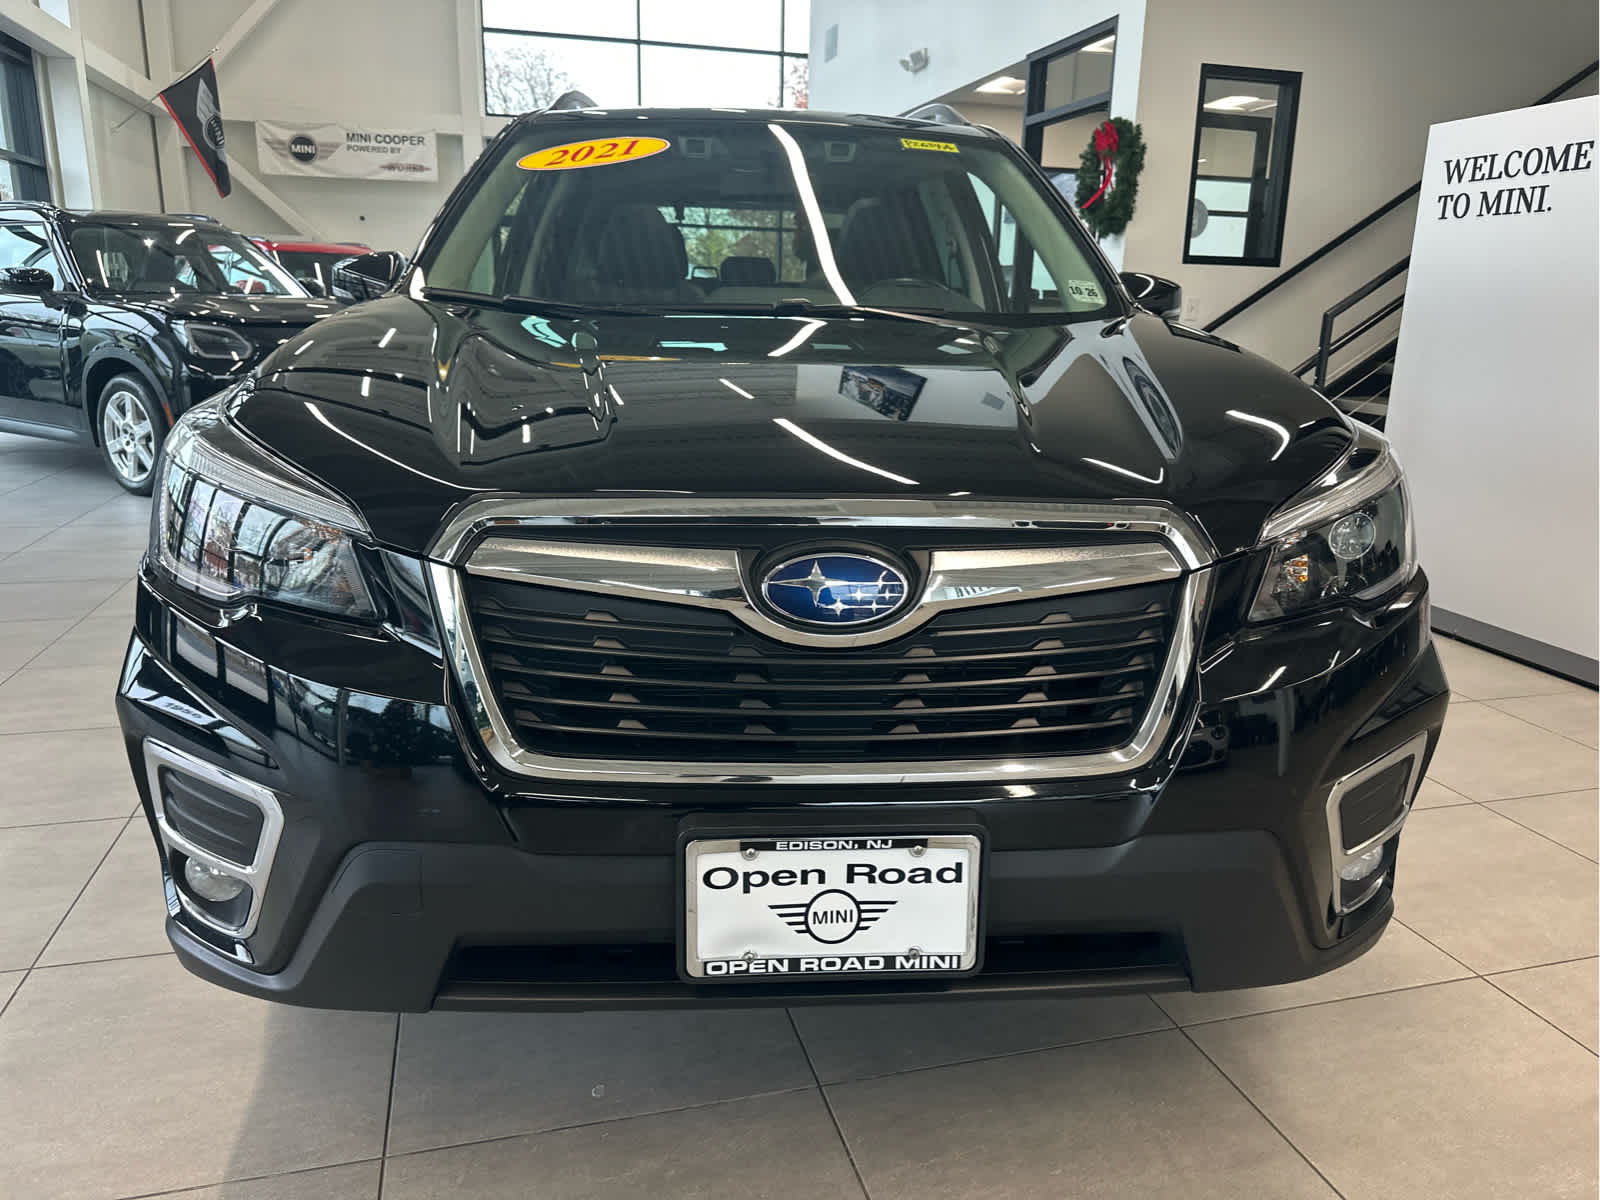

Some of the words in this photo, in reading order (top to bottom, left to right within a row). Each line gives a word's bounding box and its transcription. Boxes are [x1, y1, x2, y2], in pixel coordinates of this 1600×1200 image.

[346, 132, 371, 143] MINI
[375, 134, 425, 145] COOPER
[291, 143, 316, 154] MINI
[346, 144, 388, 153] POWERED
[544, 140, 640, 167] 2021
[1443, 140, 1595, 184] WELCOME
[1437, 192, 1471, 220] TO
[1476, 184, 1552, 217] MINI.
[775, 841, 858, 850] EDISON,
[866, 839, 893, 849] NJ
[702, 866, 826, 894] Open
[846, 862, 963, 884] Road
[812, 909, 854, 925] MINI
[705, 959, 789, 976] OPEN
[800, 956, 884, 972] ROAD
[895, 954, 959, 970] MINI
